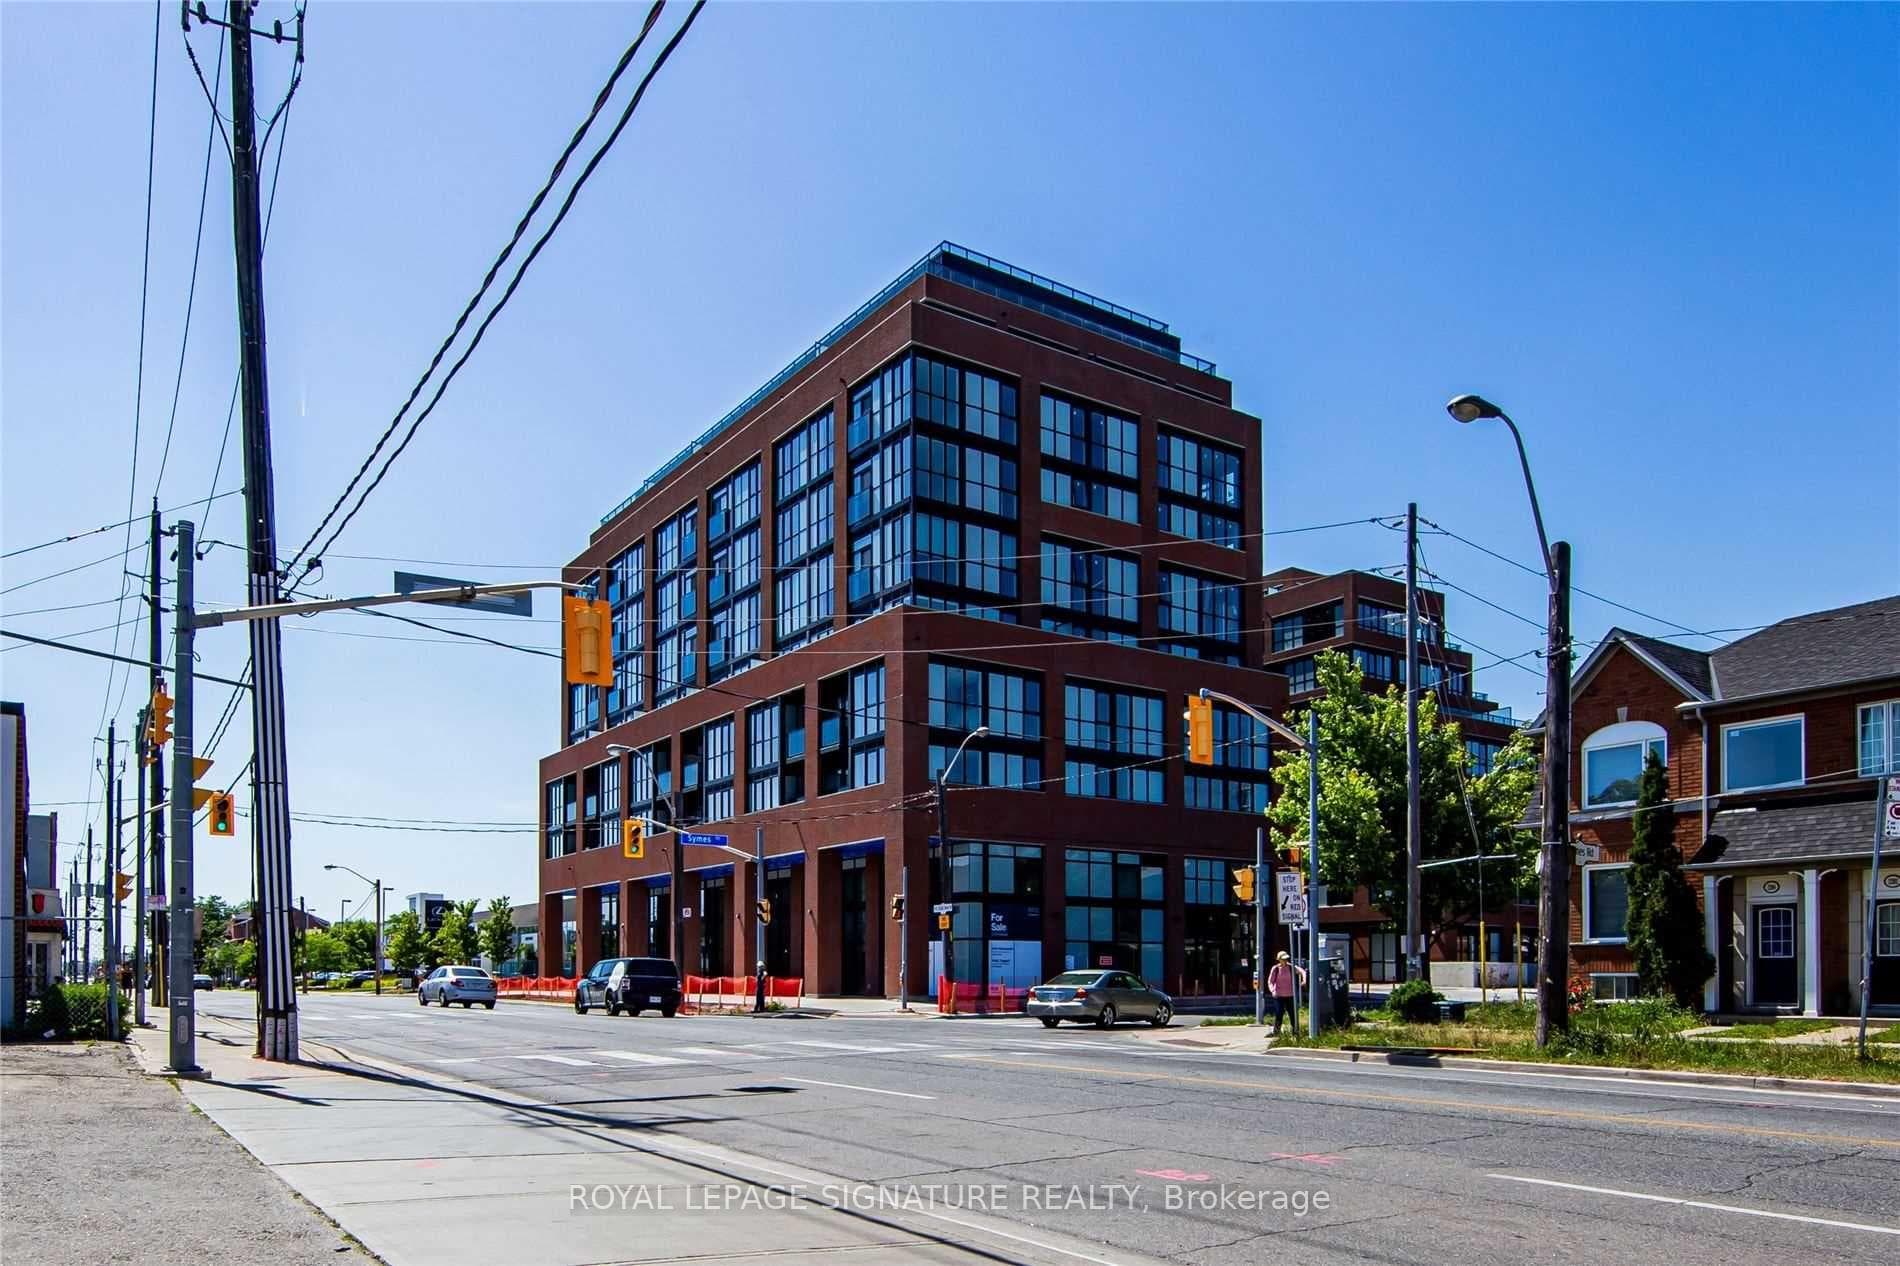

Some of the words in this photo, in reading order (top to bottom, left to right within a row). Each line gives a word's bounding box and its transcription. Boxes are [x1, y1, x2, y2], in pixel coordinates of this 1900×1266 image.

[688, 834, 712, 844] Symes
[1282, 875, 1296, 883] STOP
[991, 912, 1004, 922] For
[1282, 912, 1302, 921] SIGNAL
[991, 922, 1007, 932] Sale
